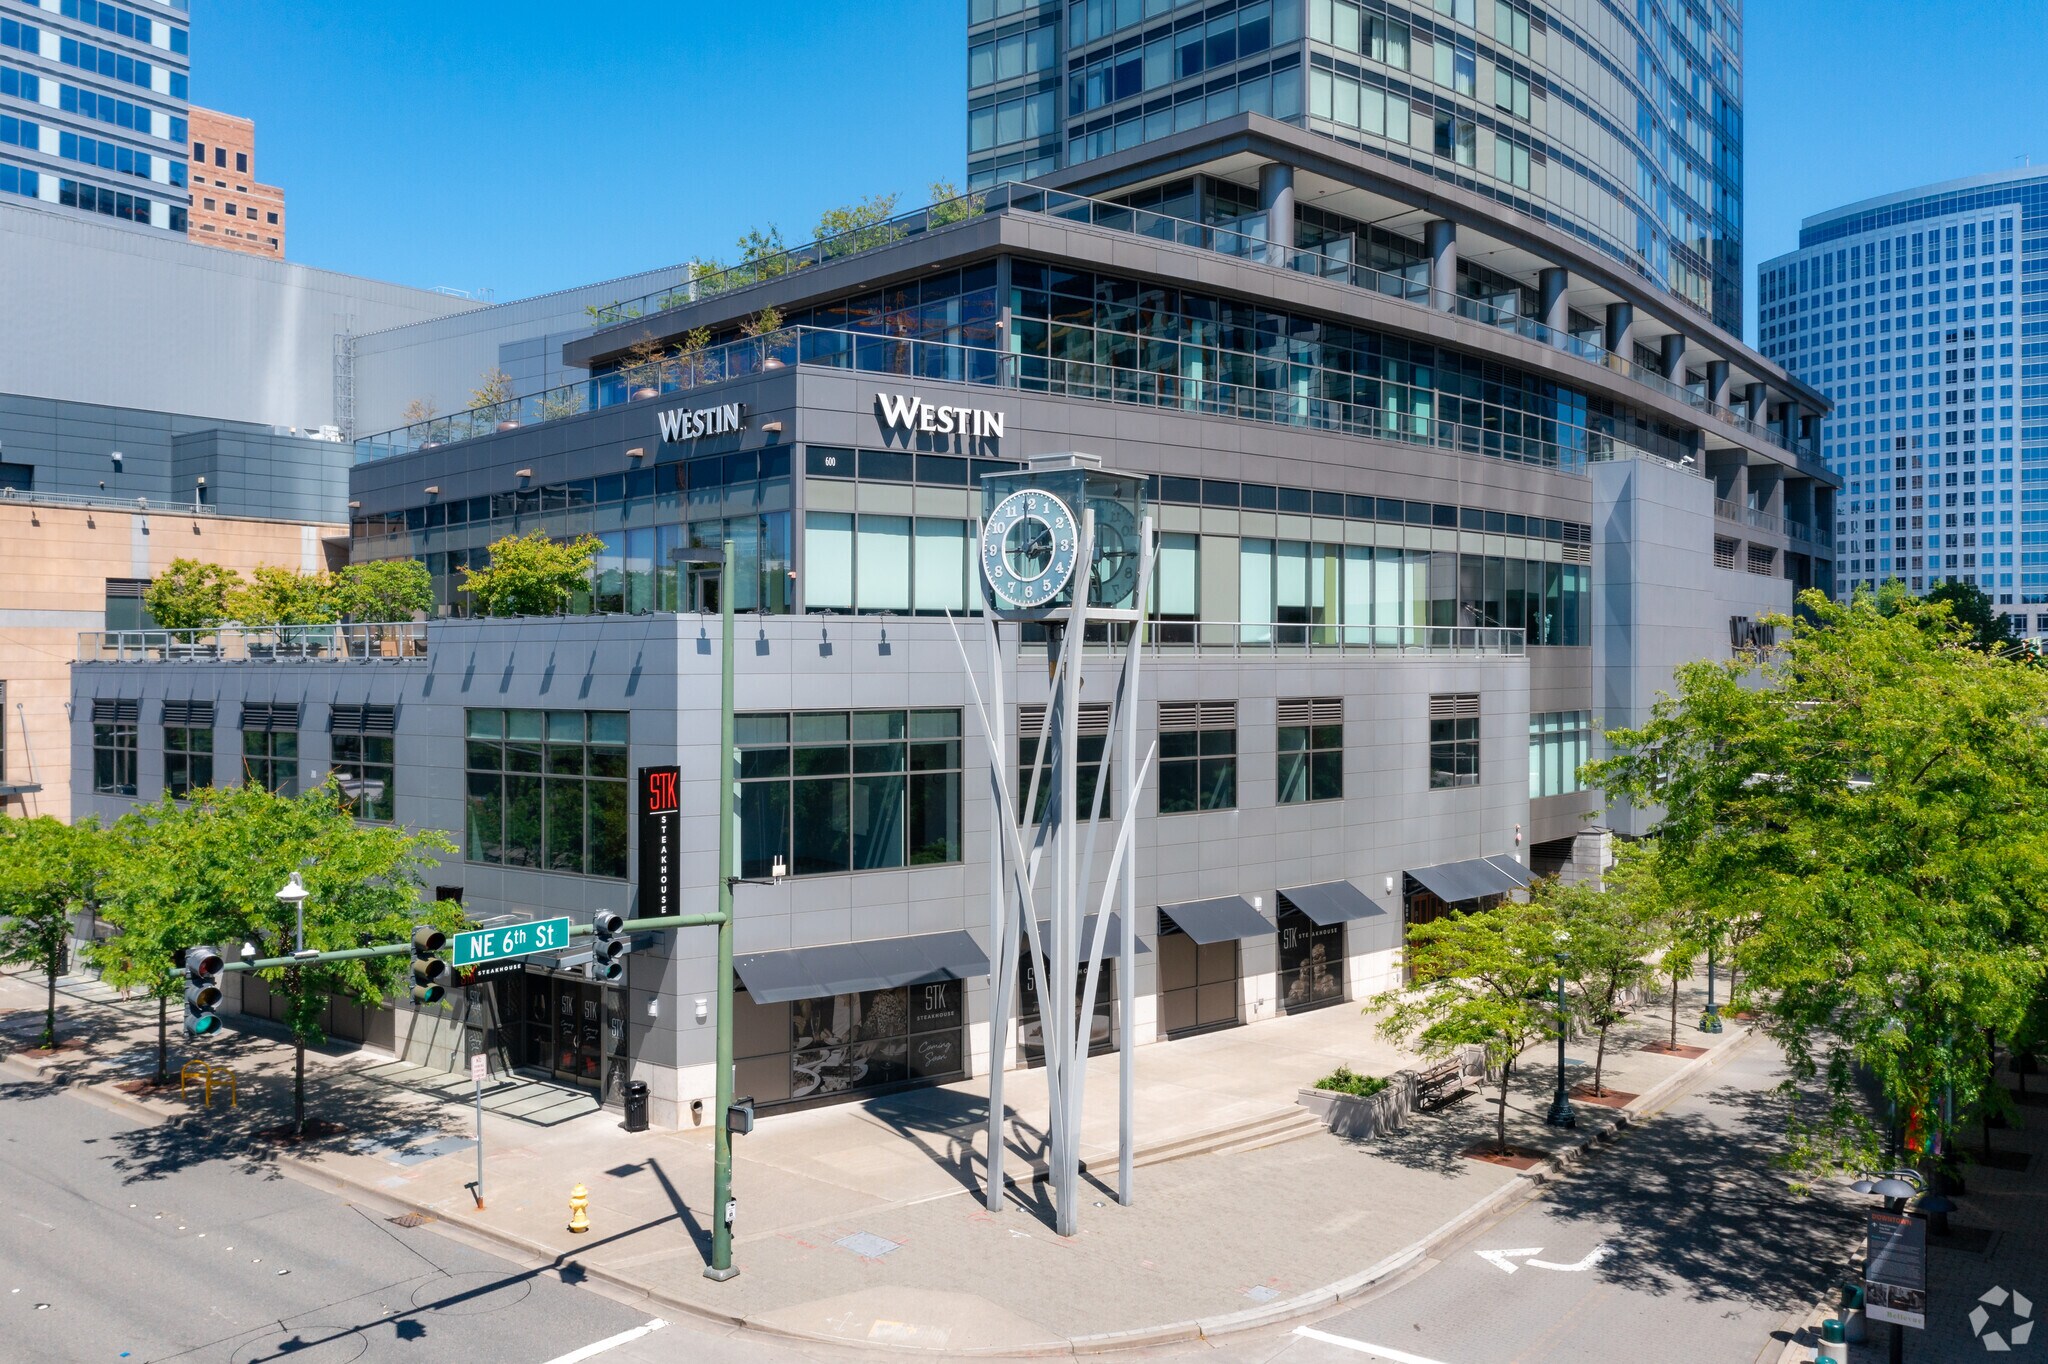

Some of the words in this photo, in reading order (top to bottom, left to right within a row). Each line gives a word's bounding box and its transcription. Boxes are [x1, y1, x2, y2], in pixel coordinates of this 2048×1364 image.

[878, 393, 1004, 438] WESTIN
[658, 402, 739, 443] WESTIN
[825, 457, 836, 467] 600
[1006, 506, 1017, 518] 11
[1043, 502, 1050, 514] 1
[992, 522, 1006, 534] 10
[1055, 517, 1064, 529] 2
[989, 544, 998, 557] 9
[1060, 539, 1069, 551] 3
[994, 565, 1003, 578] 8
[1055, 562, 1064, 574] 4
[1007, 581, 1016, 594] 7
[1024, 585, 1033, 598] 6
[1043, 579, 1052, 591] 5
[650, 772, 678, 810] STK
[470, 933, 495, 959] NE
[502, 929, 527, 953] 6th
[535, 924, 554, 948] St
[1283, 927, 1298, 949] STK
[1298, 927, 1338, 939] STEAKHOUSE
[477, 963, 522, 976] STEAKHOUSE
[925, 984, 947, 1011] STK
[561, 995, 574, 1015] STK
[584, 1000, 598, 1019] STK
[916, 1010, 955, 1021] STEAKHOUSE
[611, 1018, 625, 1038] STK
[918, 1041, 952, 1054] Coming
[924, 1051, 947, 1067] Soon
[1871, 1213, 1912, 1226] DOWNTOWN
[1886, 1311, 1922, 1325] Bellevue
